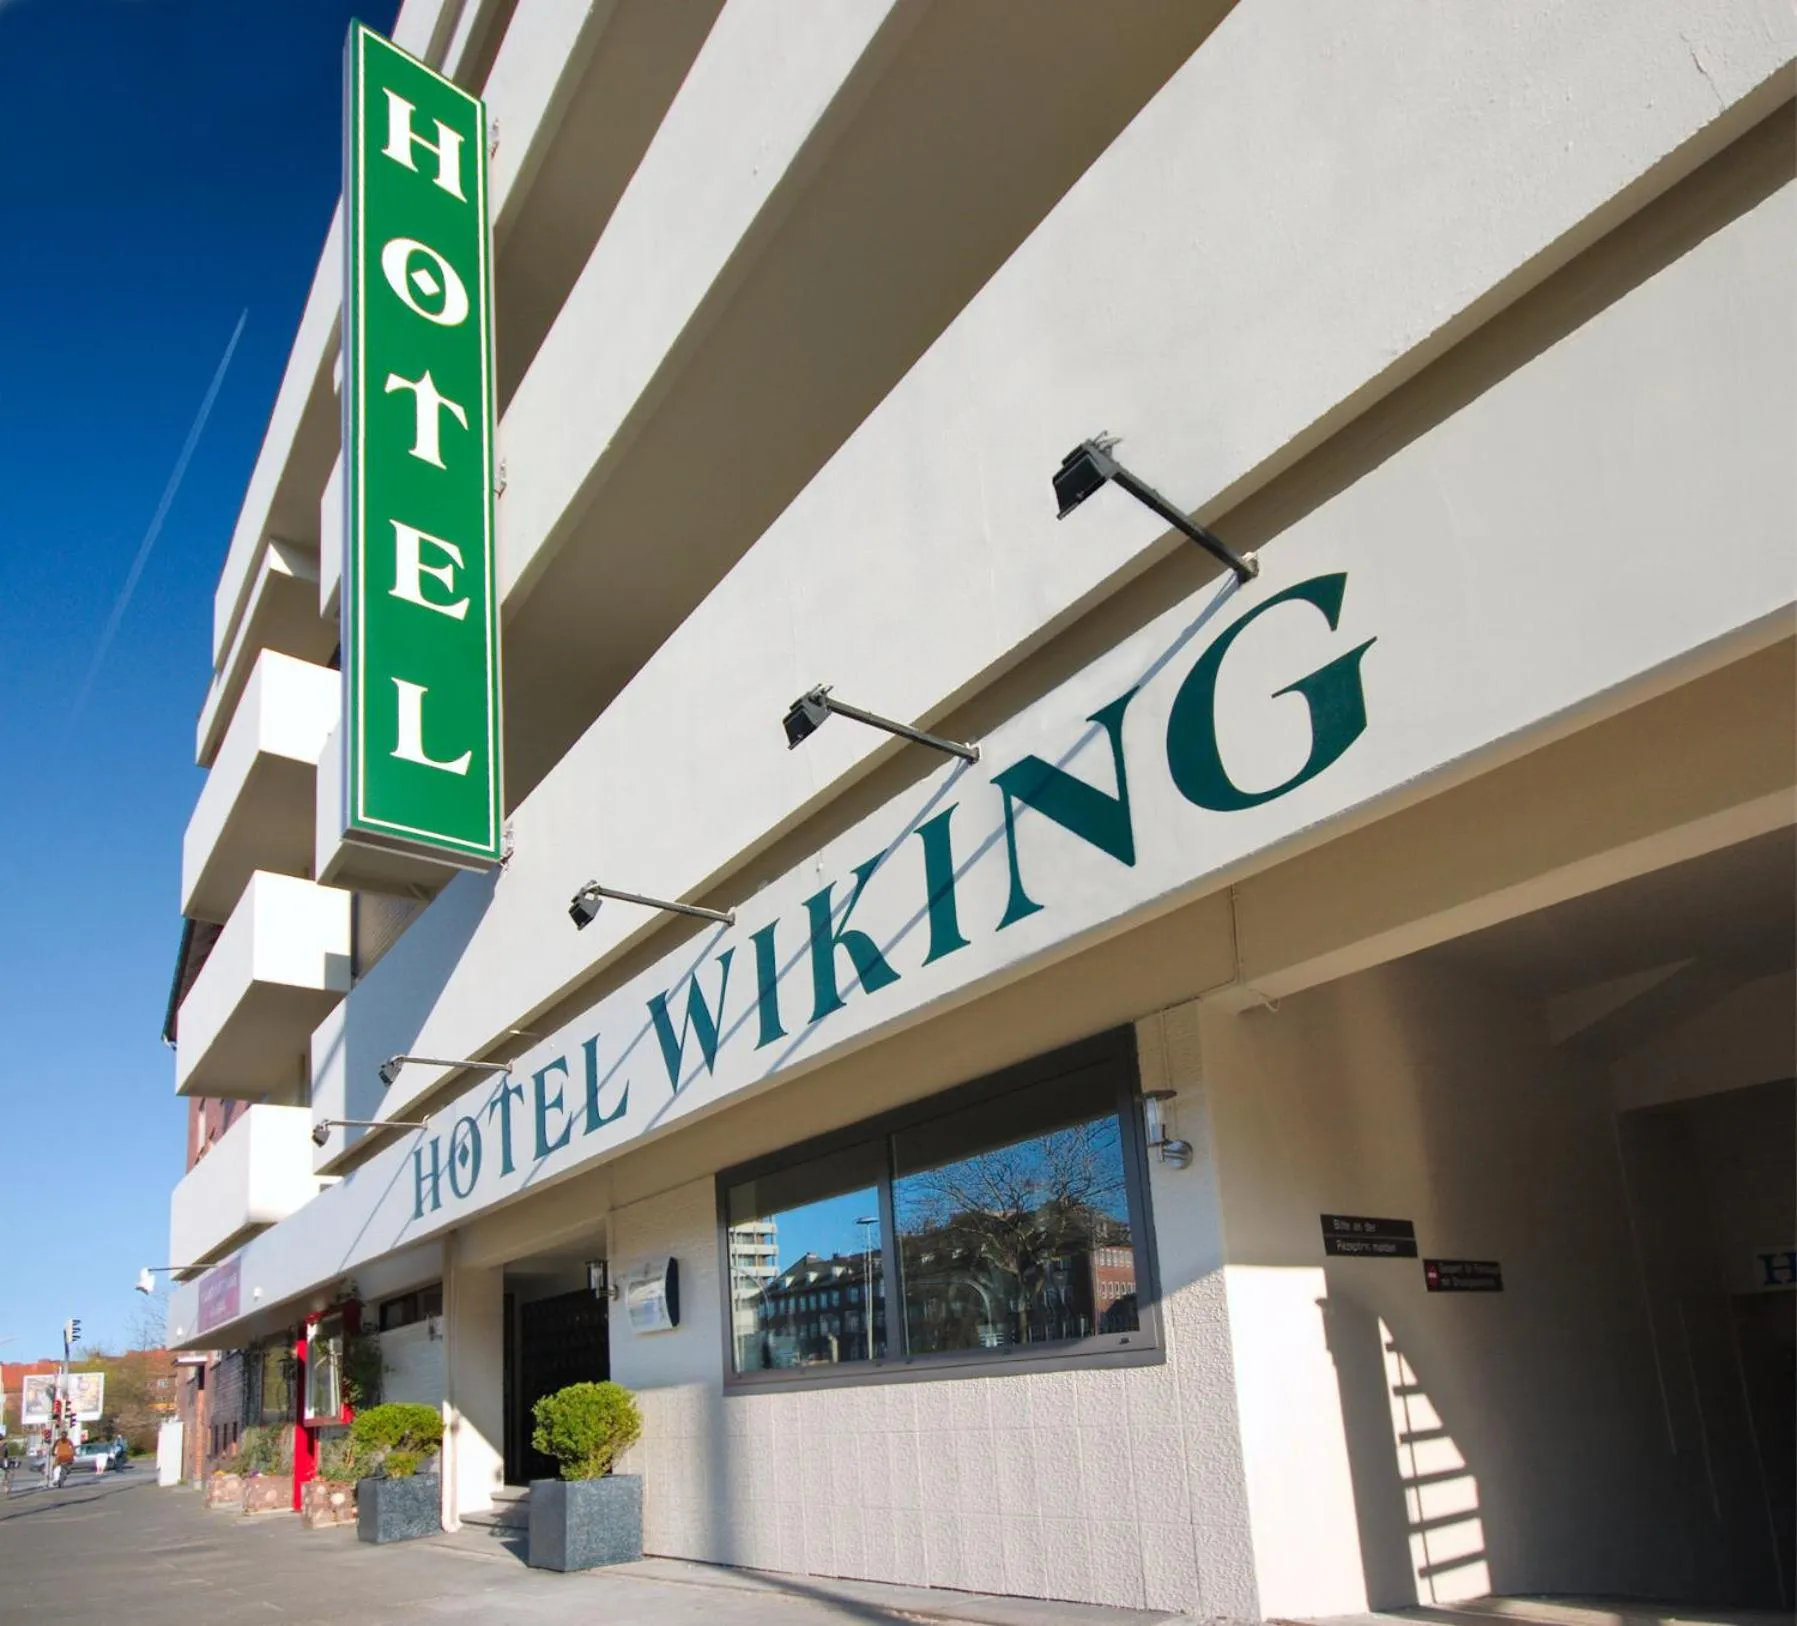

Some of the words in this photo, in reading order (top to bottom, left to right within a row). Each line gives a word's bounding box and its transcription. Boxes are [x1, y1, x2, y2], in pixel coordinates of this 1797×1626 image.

[380, 85, 473, 778] HOTEL
[412, 1031, 630, 1221] HOTEL
[645, 571, 1378, 1096] WIKING
